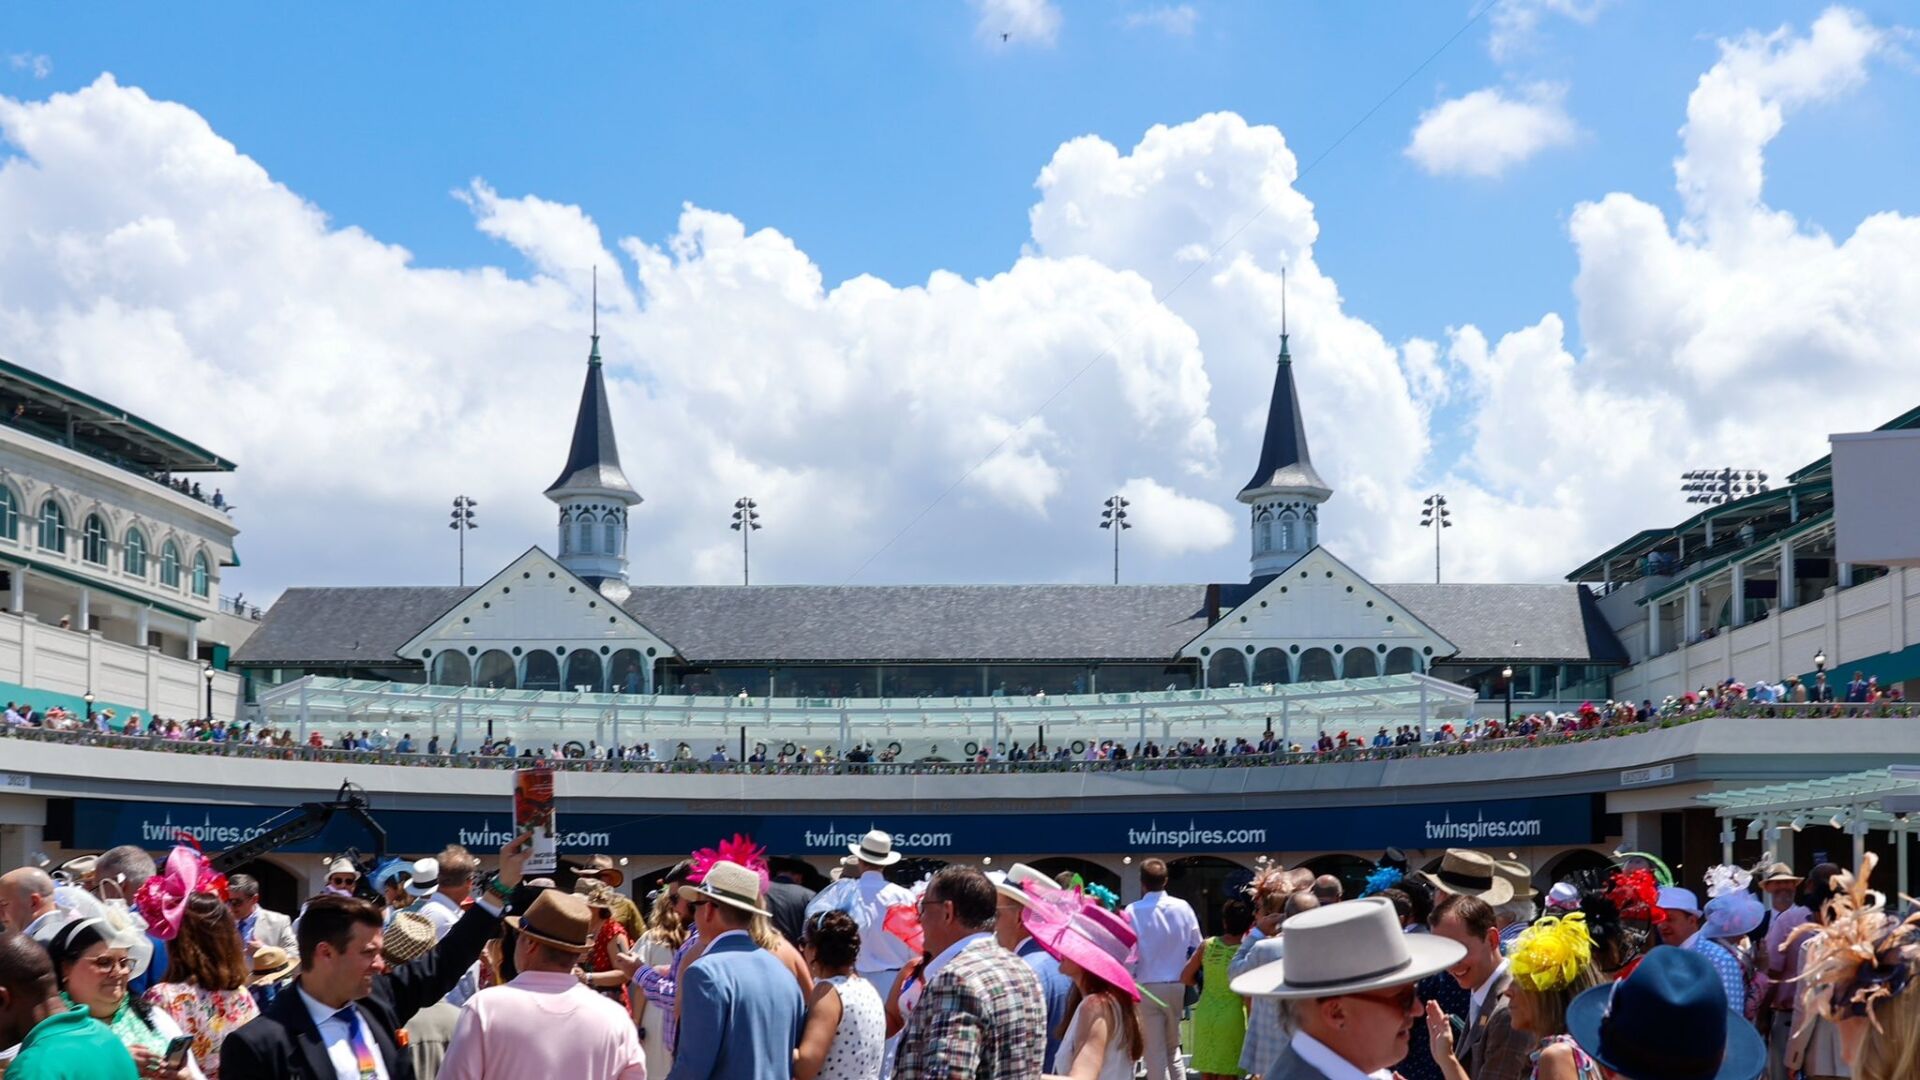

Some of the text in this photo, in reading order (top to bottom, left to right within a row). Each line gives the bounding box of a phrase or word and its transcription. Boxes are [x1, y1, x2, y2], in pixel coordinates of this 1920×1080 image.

[142, 811, 273, 843] twinspires.co
[1128, 817, 1266, 848] twinspires.com
[1425, 808, 1541, 842] twinspires.com
